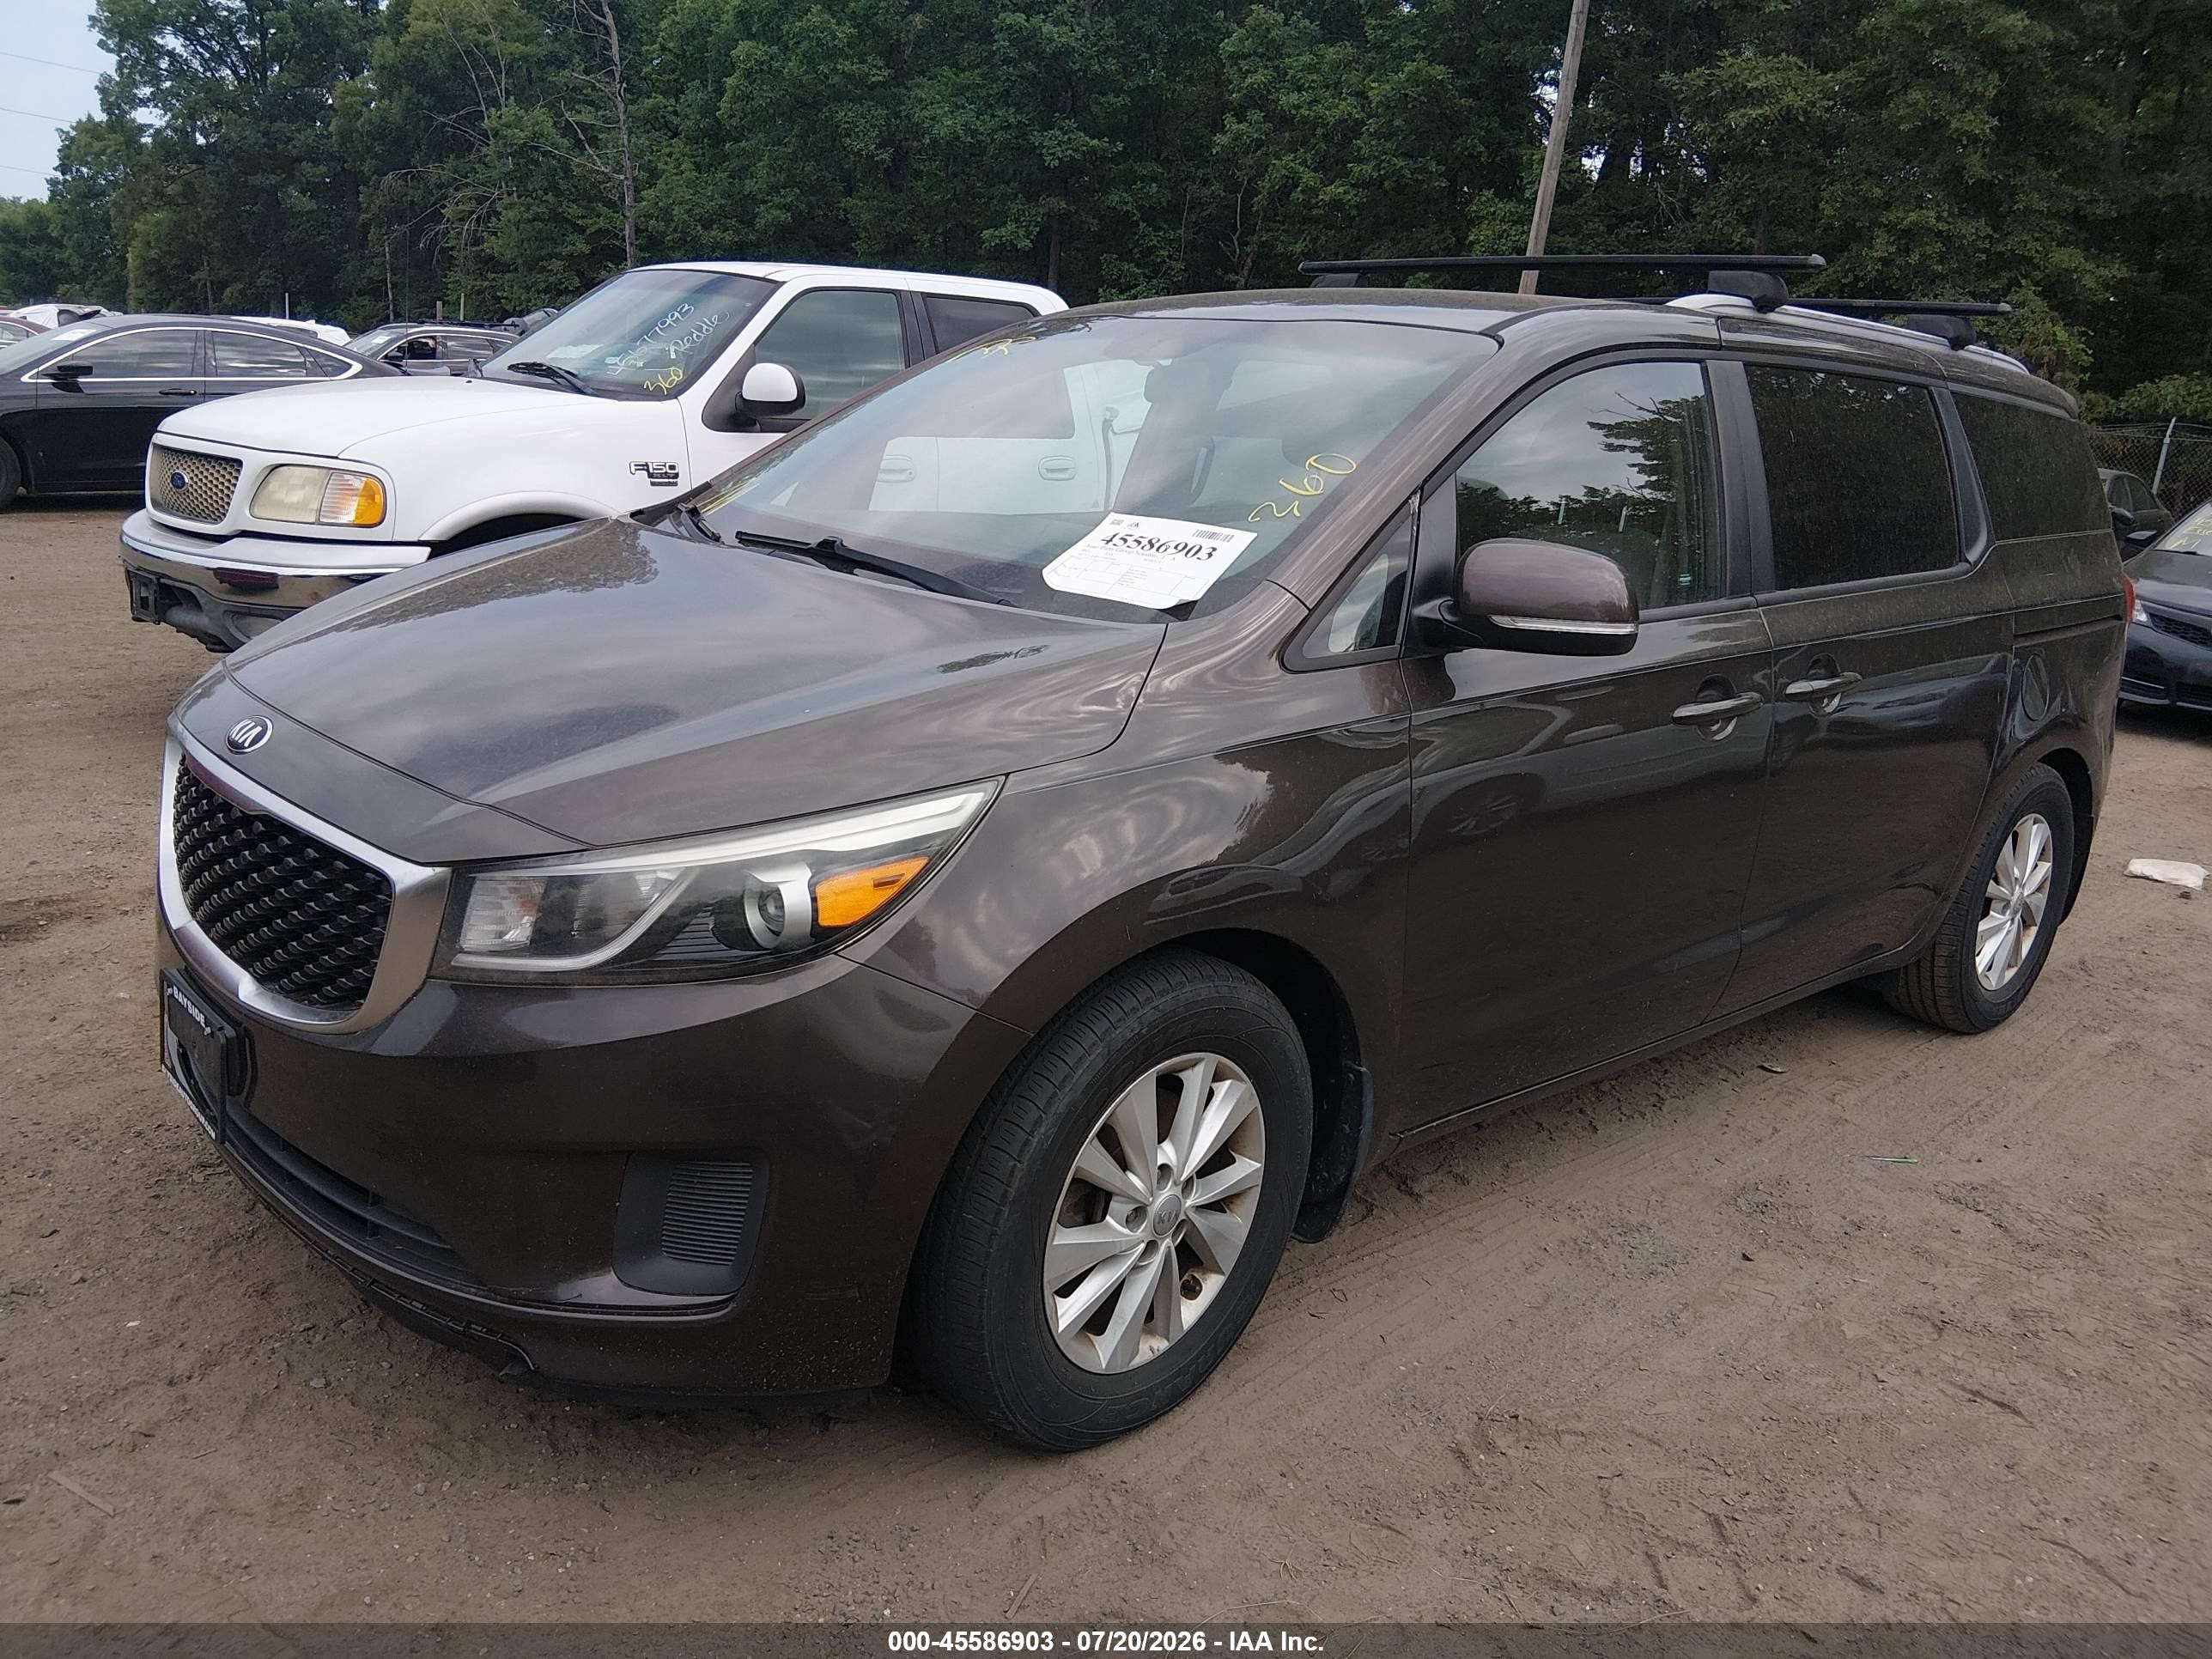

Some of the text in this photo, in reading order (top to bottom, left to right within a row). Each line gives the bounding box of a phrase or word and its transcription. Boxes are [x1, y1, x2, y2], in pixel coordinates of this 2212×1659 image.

[643, 366, 684, 396] 360
[1248, 453, 1358, 523] 360
[1100, 532, 1218, 561] 45586903
[231, 720, 263, 748] KIA
[173, 984, 206, 1029] BAYSIDE
[1157, 1209, 1178, 1225] KIA
